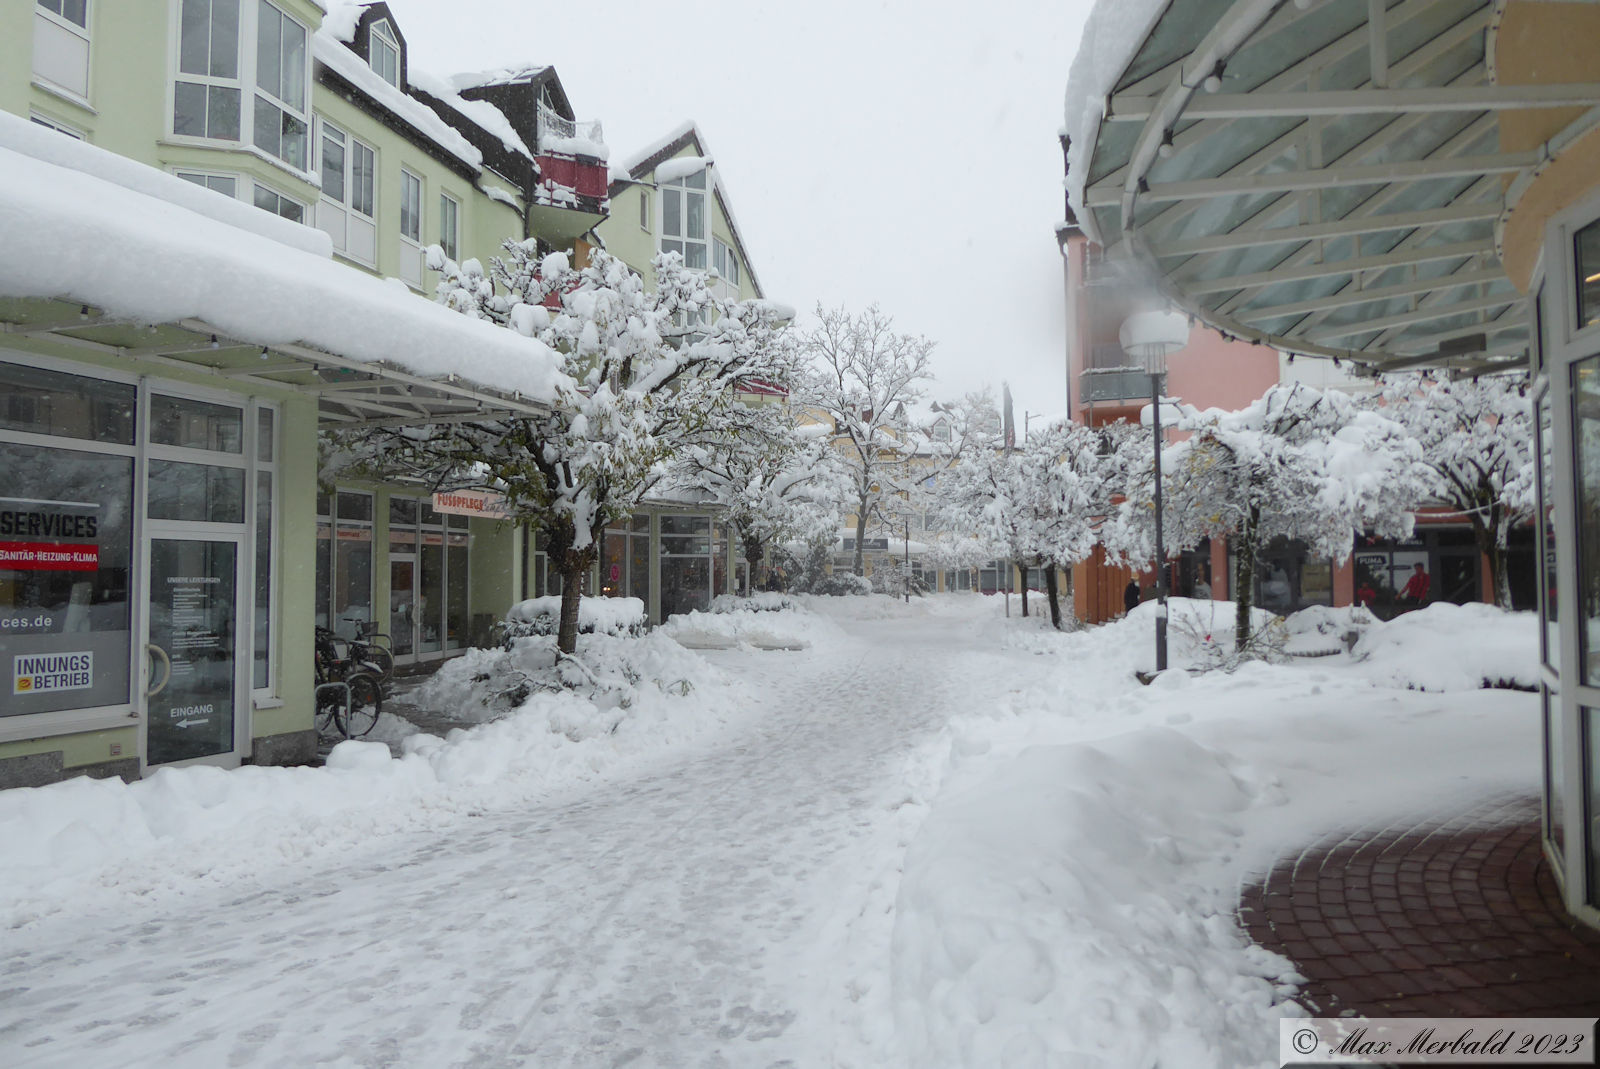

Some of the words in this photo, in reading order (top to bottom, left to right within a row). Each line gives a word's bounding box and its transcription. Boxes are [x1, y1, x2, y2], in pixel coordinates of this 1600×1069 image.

[0, 511, 97, 538] SERVICES
[17, 655, 90, 675] INNUNGS
[34, 672, 89, 689] BETRIEB
[170, 704, 213, 718] EINGANG
